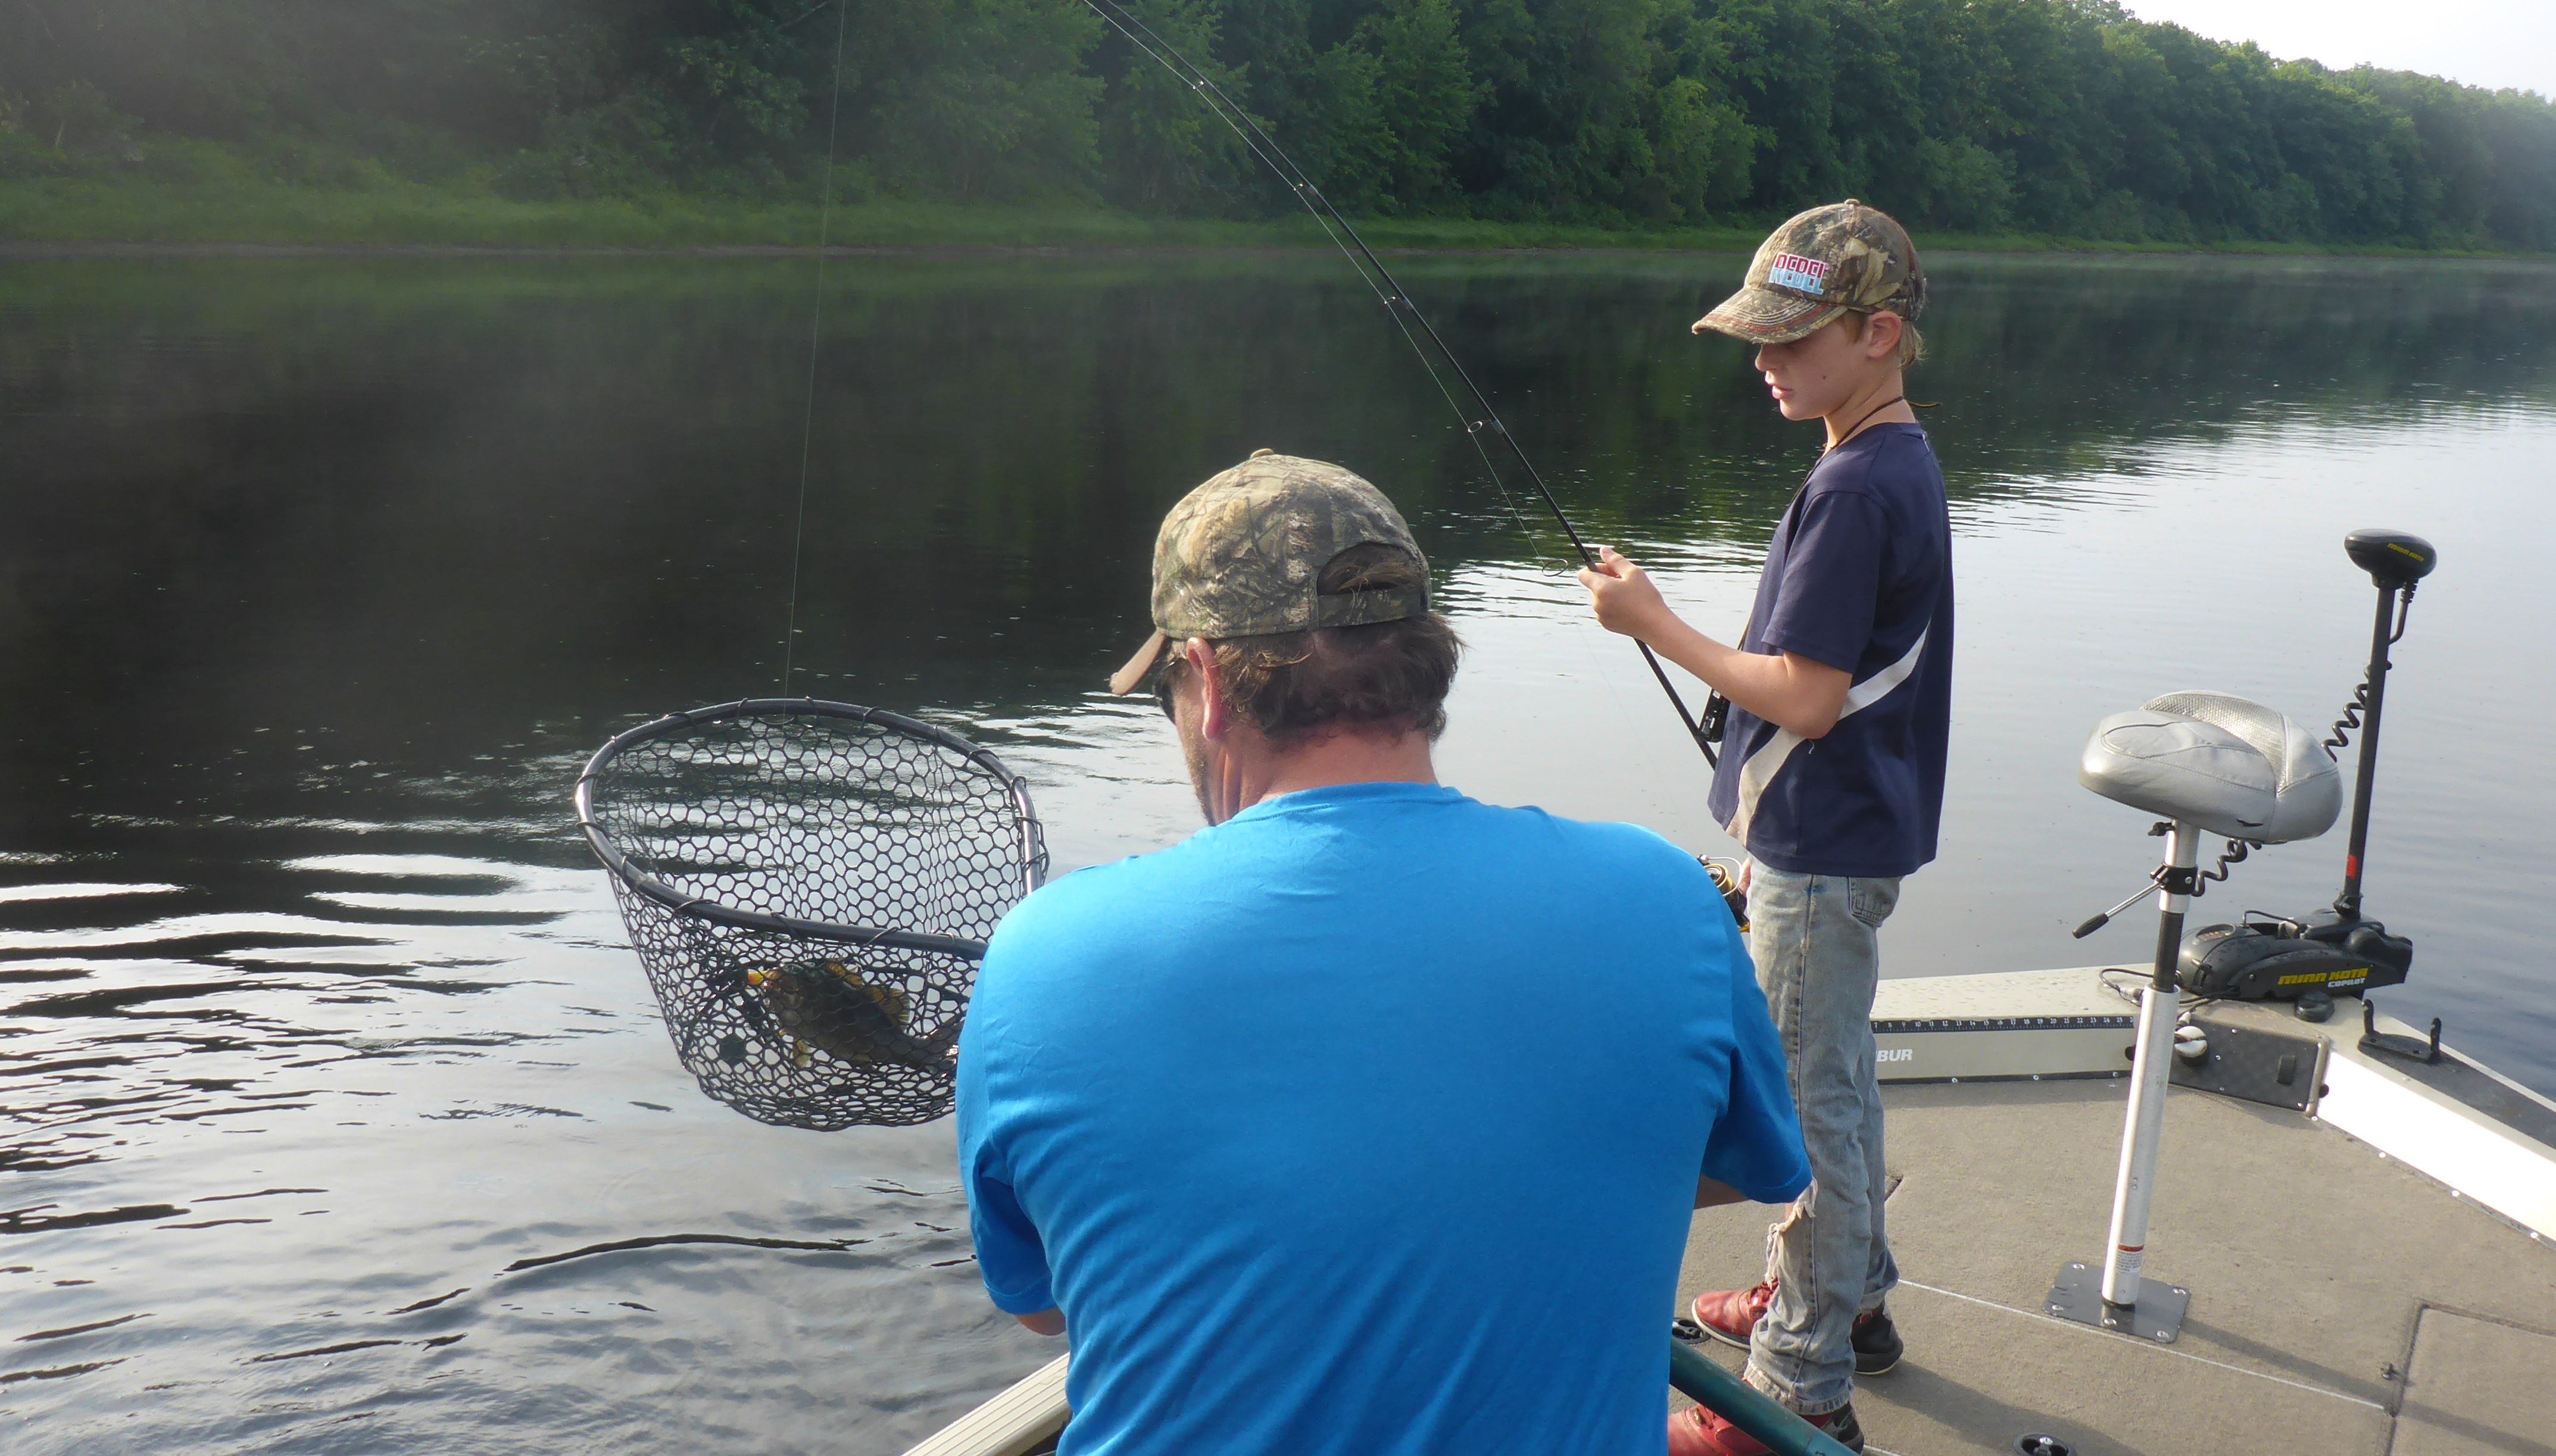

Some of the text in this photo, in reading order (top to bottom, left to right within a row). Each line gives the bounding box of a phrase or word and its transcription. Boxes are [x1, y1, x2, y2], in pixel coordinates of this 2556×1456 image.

[1768, 252, 1824, 295] REBEL
[2328, 968, 2369, 981] KOTA
[2327, 977, 2366, 988] COPILOT
[1875, 1049, 1912, 1062] BUR
